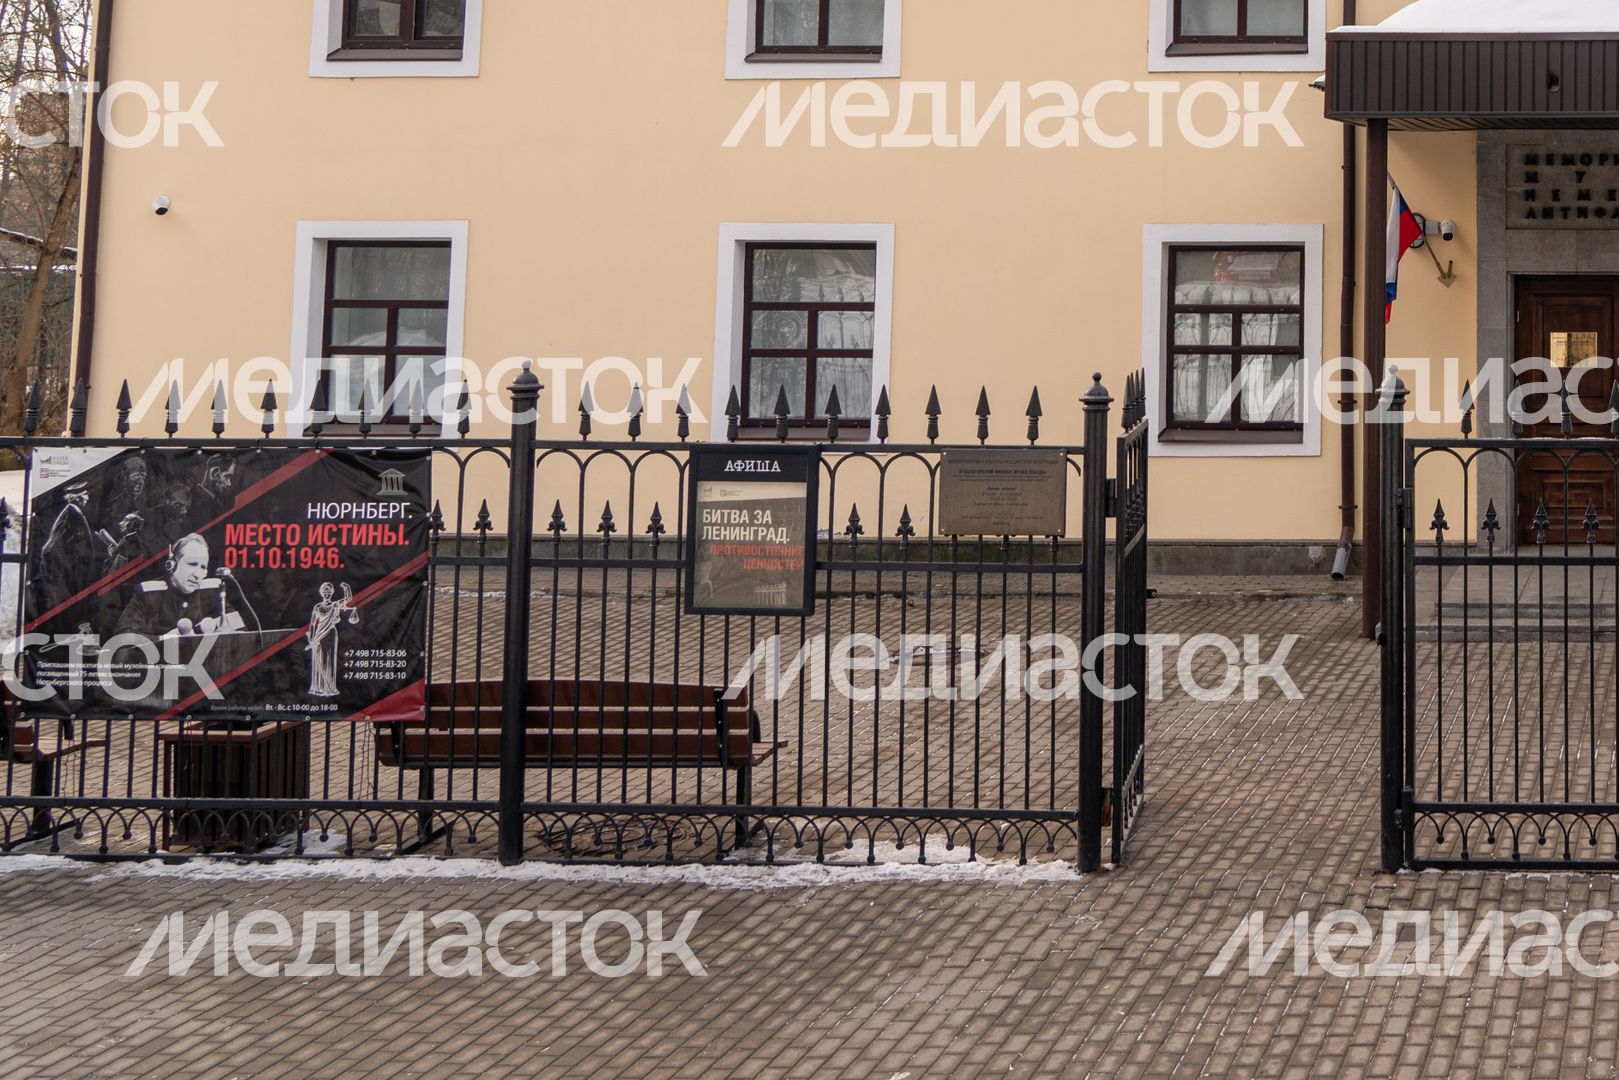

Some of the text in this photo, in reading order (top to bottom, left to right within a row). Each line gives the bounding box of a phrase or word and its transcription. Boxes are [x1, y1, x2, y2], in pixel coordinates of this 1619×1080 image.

[724, 460, 781, 472] АФИША
[307, 502, 413, 519] НЮРНБЕРГ.
[702, 509, 772, 524] БИТВА ЗА
[225, 523, 410, 546] МЕСТО ИСТИНЫ.
[702, 526, 790, 544] ЛЕНИНГРАД.
[224, 546, 345, 569] 01.10.1946.
[310, 704, 319, 712] до
